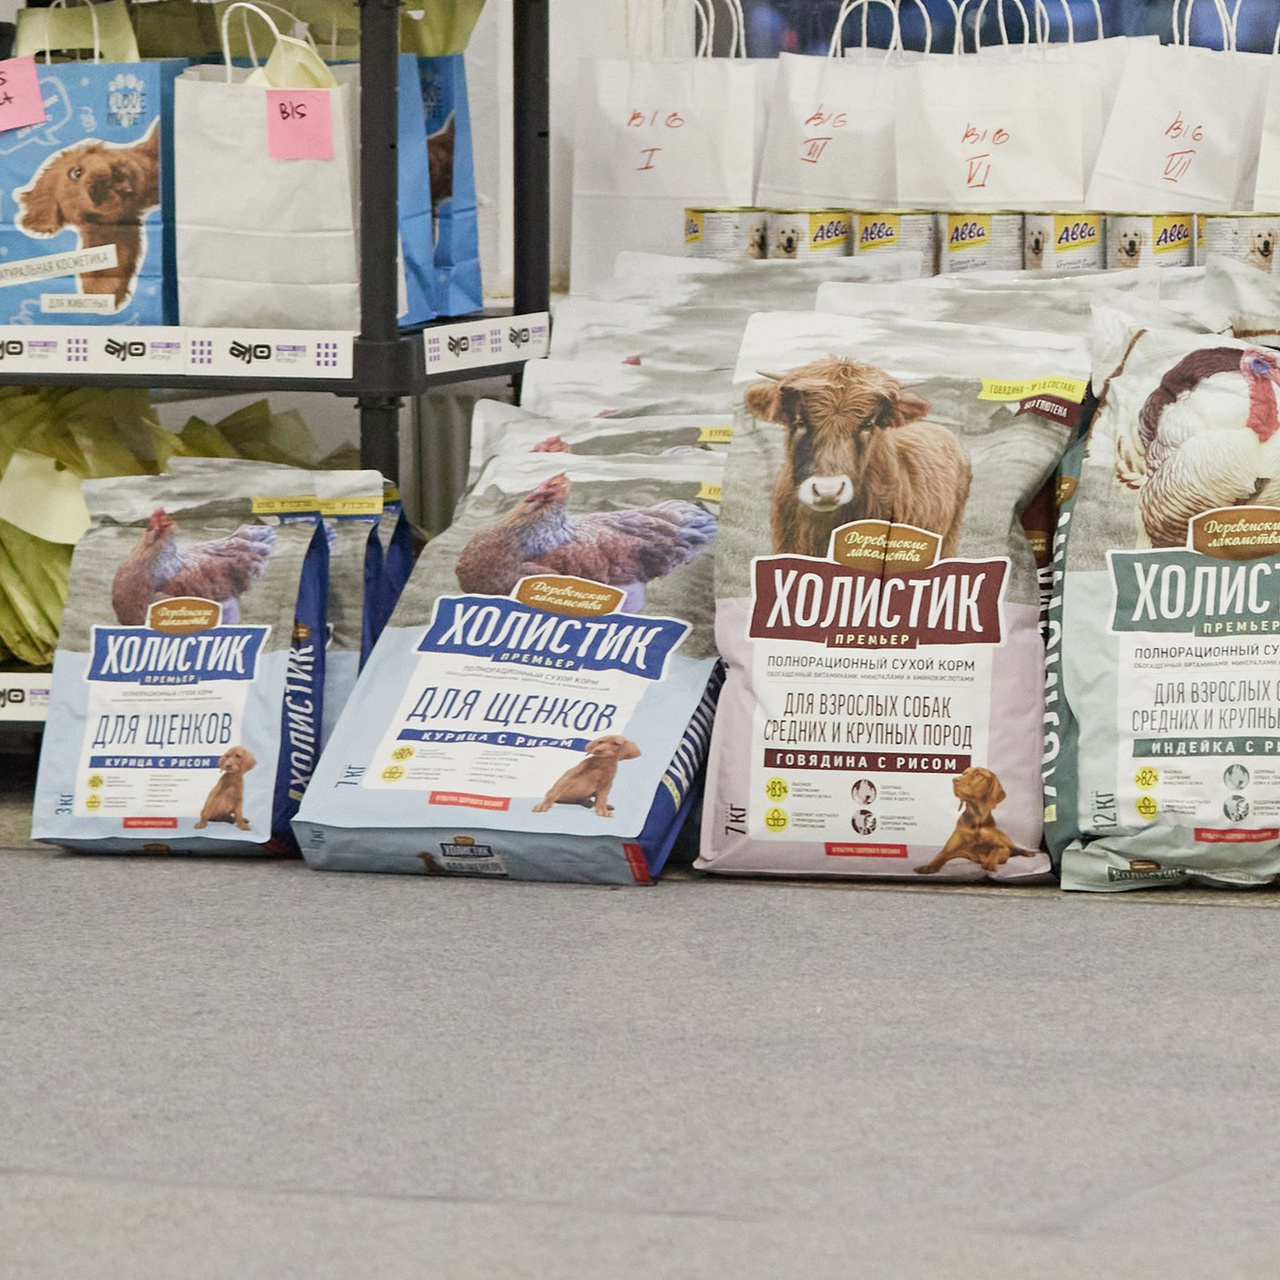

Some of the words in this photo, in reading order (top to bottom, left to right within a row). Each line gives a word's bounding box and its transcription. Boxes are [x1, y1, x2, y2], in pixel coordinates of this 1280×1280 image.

[845, 532, 928, 550] Деревенские
[530, 581, 612, 601] Деревенские
[765, 568, 987, 633] ХОЛИСТИК
[1204, 620, 1280, 633] ПРЕМЬЕР
[437, 603, 663, 670] ХОЛИСТИК
[835, 633, 910, 646] ПРЕМЬЕР
[101, 634, 252, 675] ХОЛИСТИК
[1135, 643, 1259, 659] ПОЛНОРАЦИОННЫЙ
[500, 652, 575, 669] ПРЕМЬЕР
[767, 655, 888, 670] ПОЛНОРАЦИОННЫЙ
[892, 658, 934, 671] СУХОЙ
[938, 659, 975, 671] КОРМ
[144, 674, 196, 684] ПРЕМЬЕР
[1154, 682, 1186, 707] ДЛЯ
[1191, 680, 1270, 704] ВЗРОСЛЫХ
[407, 686, 482, 722] ДЛЯ
[483, 692, 618, 733] ЩЕНКОВ
[784, 692, 815, 717] ДЛЯ
[820, 693, 898, 718] ВЗРОСЛЫХ
[903, 696, 952, 719] СОБАК
[1132, 709, 1198, 733] СРЕДНИХ
[1204, 710, 1213, 730] И
[91, 714, 140, 749] ДЛЯ
[145, 712, 232, 750] ЩЕНКОВ
[421, 731, 488, 742] КУРИЦА
[499, 734, 506, 745] С
[763, 719, 826, 744] СРЕДНИХ
[832, 721, 841, 743] И
[846, 722, 918, 746] КРУПНЫХ
[923, 724, 972, 750] ПОРОД
[1152, 739, 1235, 755] ИНДЕЙКА
[1246, 740, 1254, 753] С
[105, 758, 152, 767] КУРИЦА
[158, 758, 165, 767] С
[170, 758, 211, 767] РИСОМ
[776, 753, 868, 769] ГОВЯДИНА
[878, 756, 887, 769] С
[897, 757, 958, 771] РИСОМ
